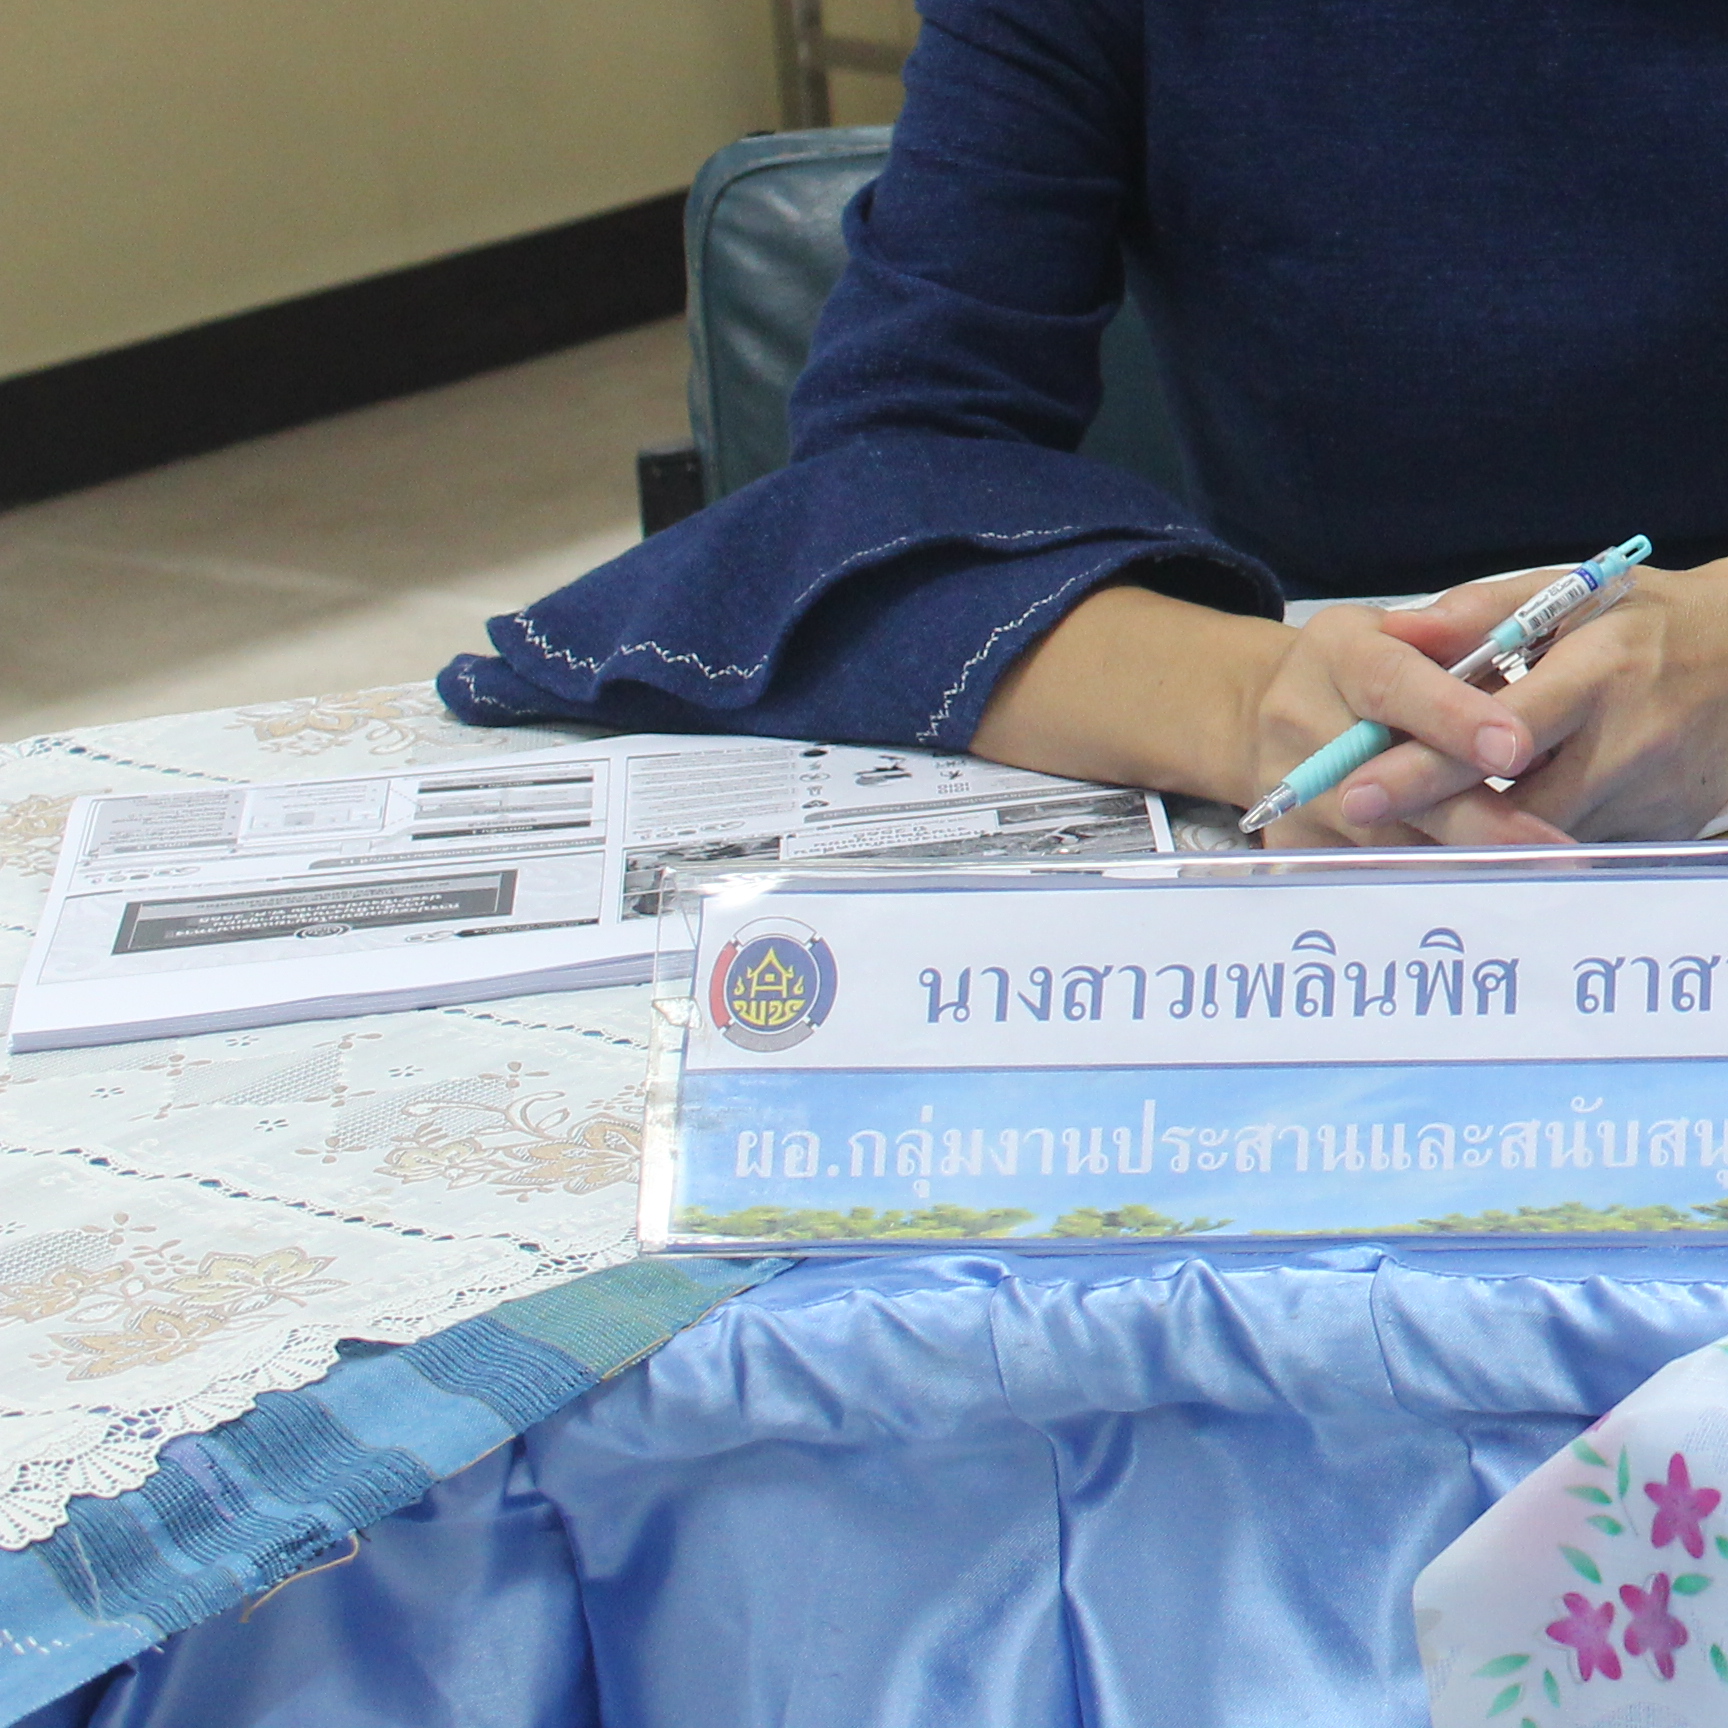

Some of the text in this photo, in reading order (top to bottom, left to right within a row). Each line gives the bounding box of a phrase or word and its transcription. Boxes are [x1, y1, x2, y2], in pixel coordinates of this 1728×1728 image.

[918, 927, 1521, 1024] นางสาวเพลินพิศ
